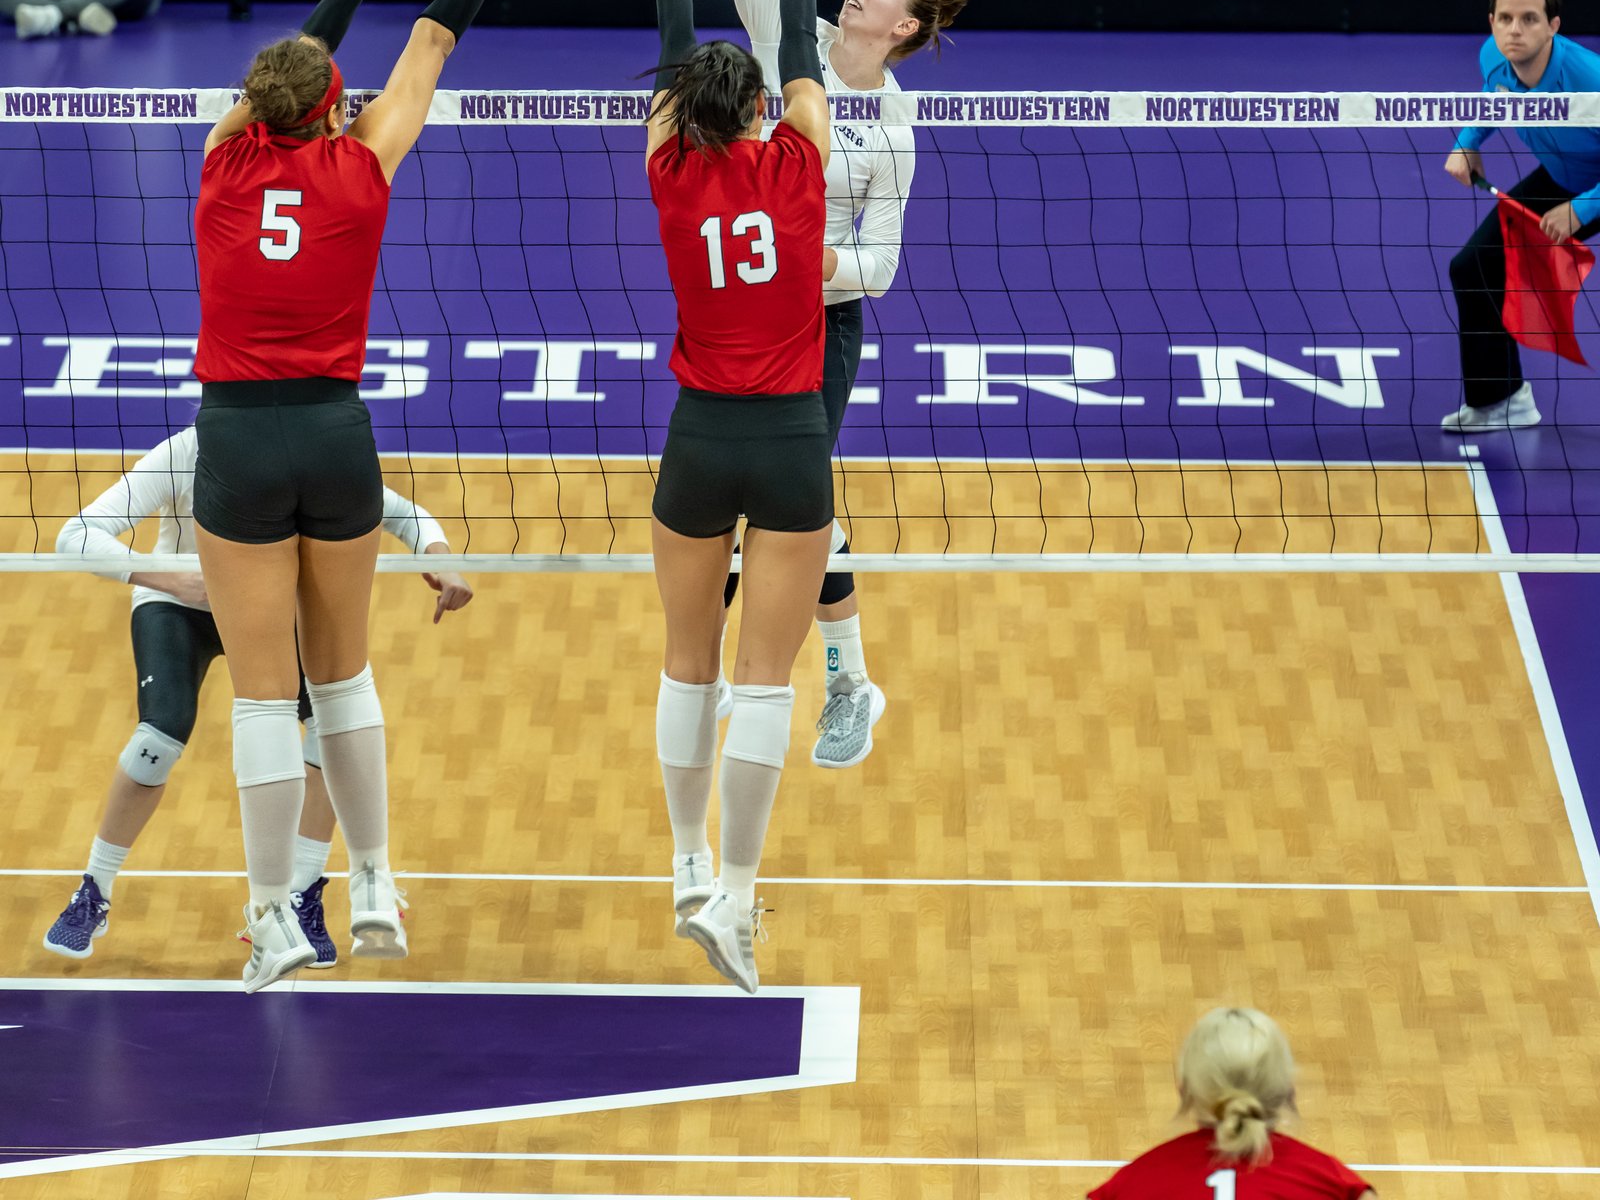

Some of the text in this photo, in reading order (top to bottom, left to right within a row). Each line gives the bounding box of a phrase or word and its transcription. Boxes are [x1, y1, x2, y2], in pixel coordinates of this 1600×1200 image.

[5, 93, 197, 118] NORTHWESTERN
[916, 96, 1110, 121] NORTHWESTERN
[1145, 97, 1340, 122] NORTHWESTERN
[1375, 97, 1569, 122] NORTHWESTERN
[259, 189, 302, 261] 5
[700, 210, 778, 289] 13
